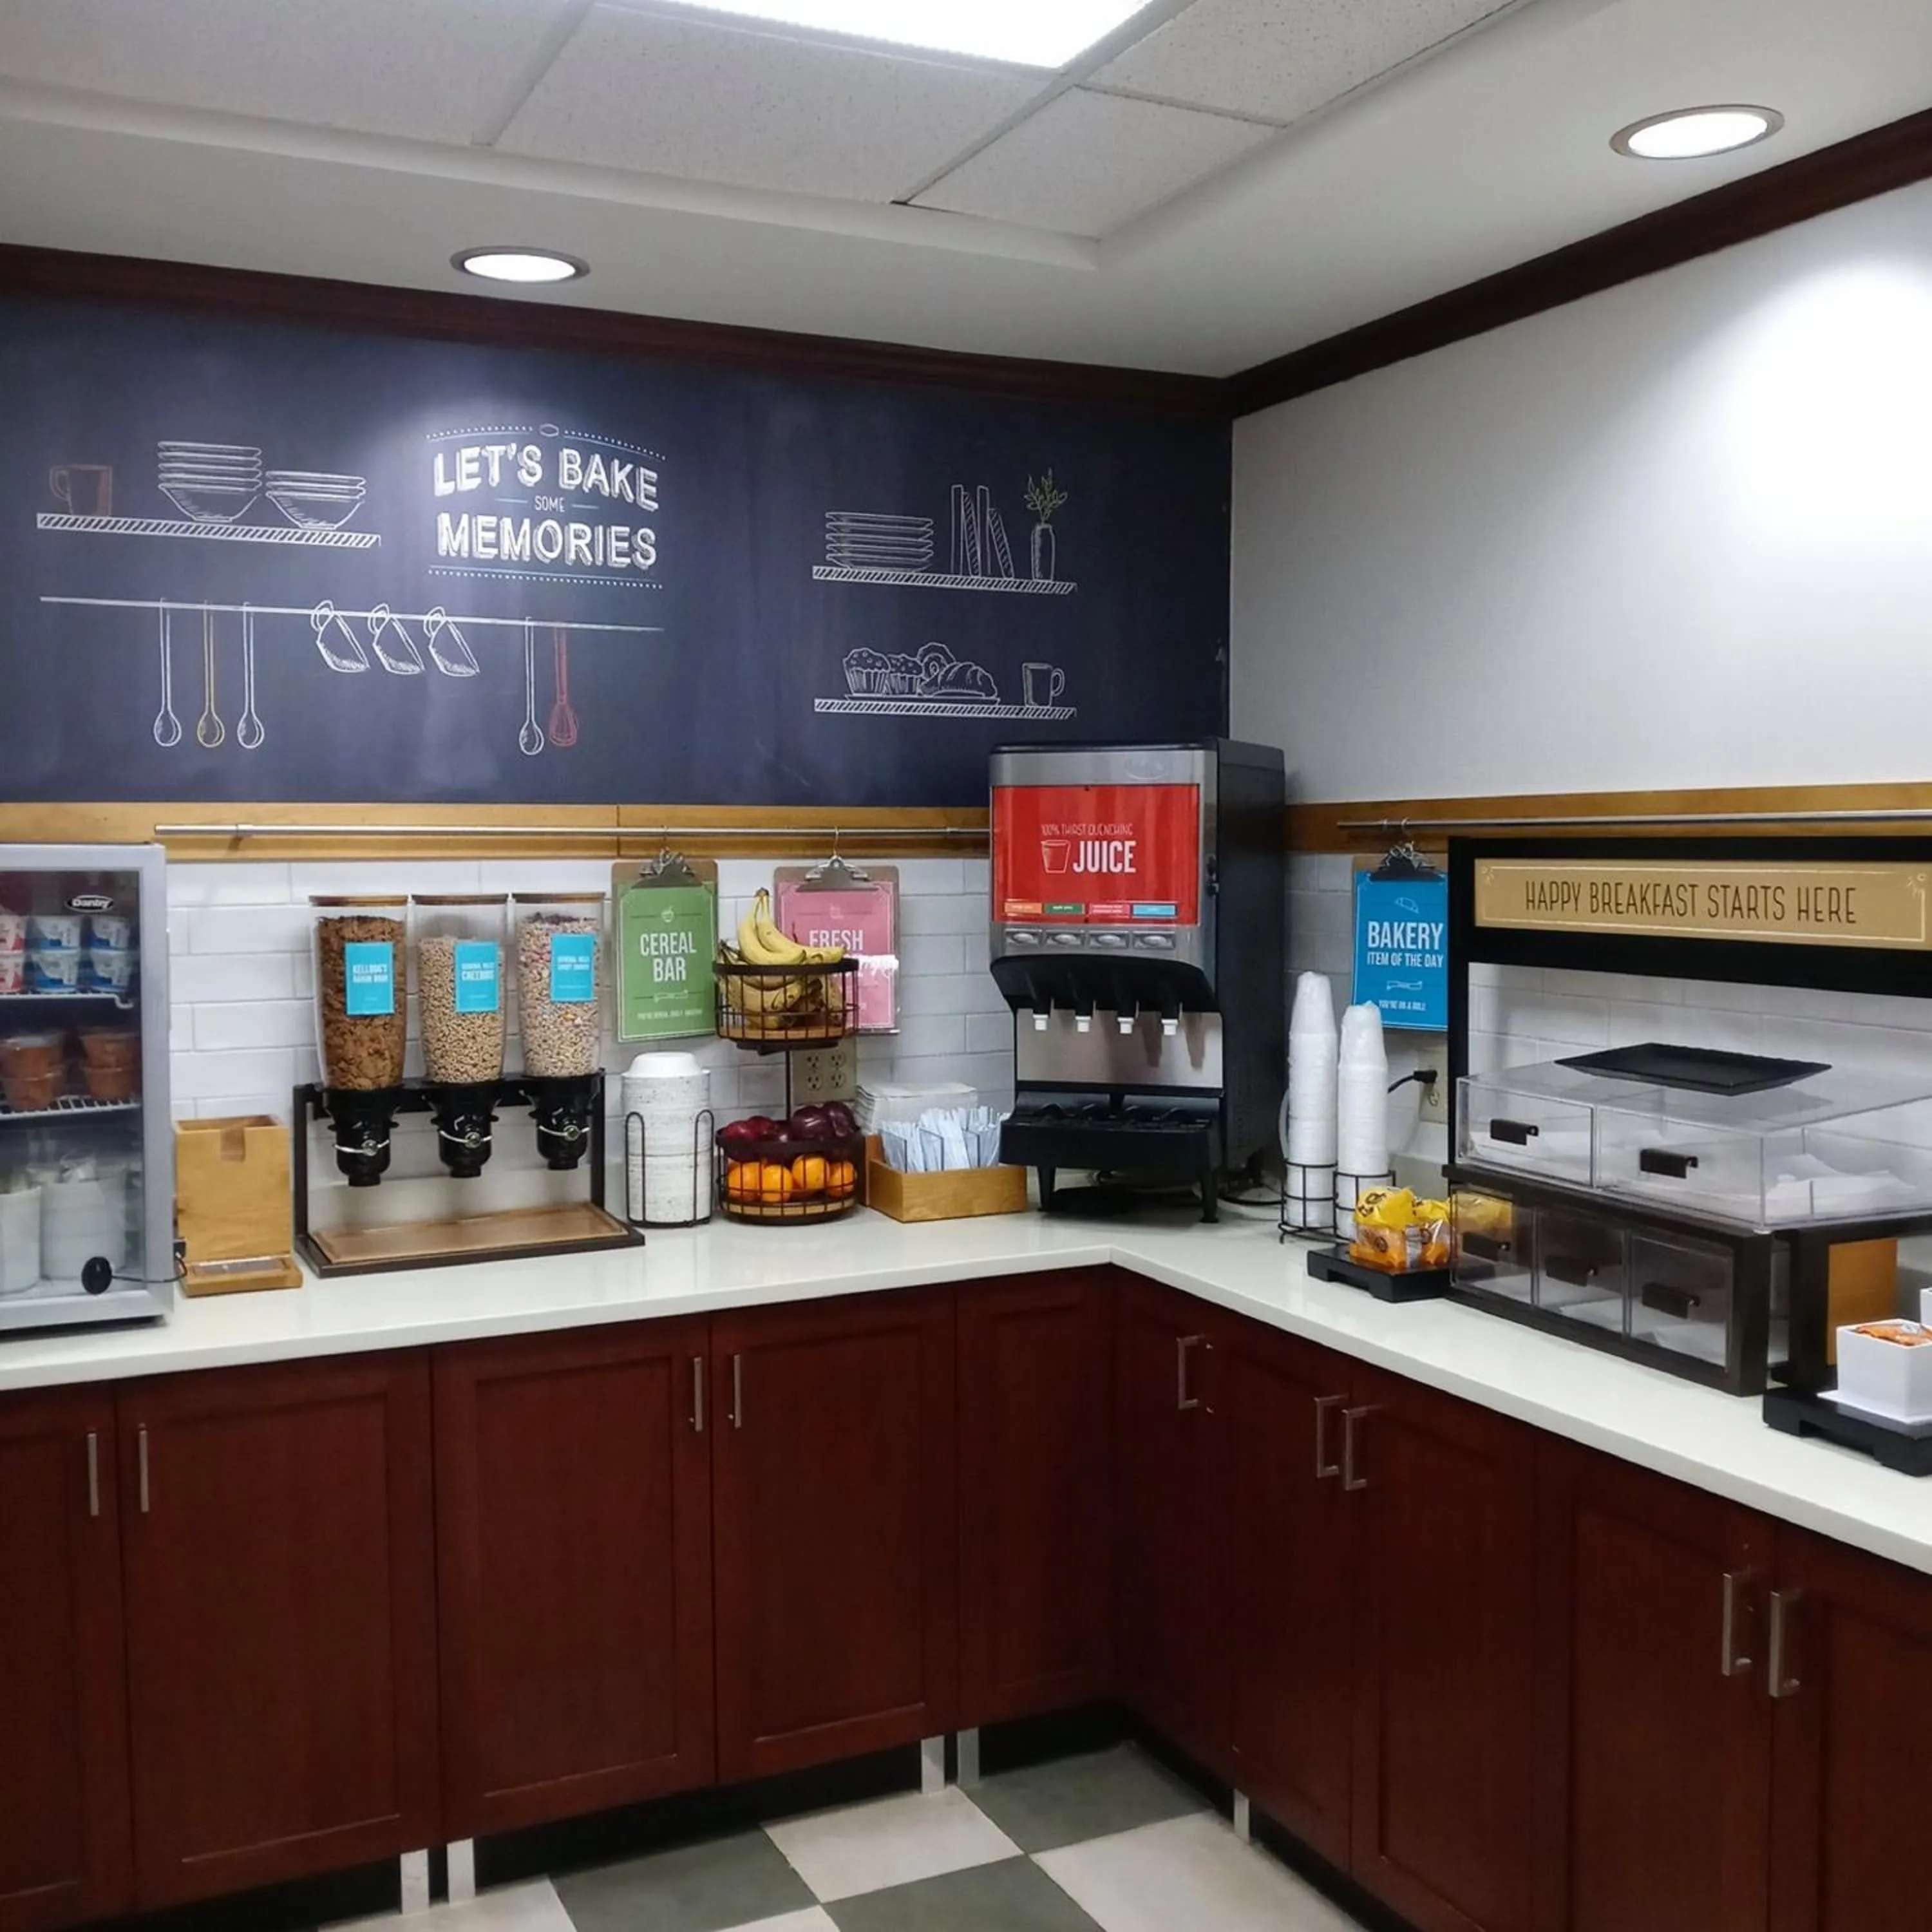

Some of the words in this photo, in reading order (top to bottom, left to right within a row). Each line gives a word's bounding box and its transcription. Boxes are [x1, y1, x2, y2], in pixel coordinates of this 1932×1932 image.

[433, 443, 544, 497] LET'S
[558, 448, 659, 511] BAKE
[535, 496, 565, 513] SOME
[437, 513, 657, 570] MEMORIES
[1072, 840, 1137, 873] JUICE
[1525, 880, 1582, 914] HAPPY
[1589, 882, 1699, 917] BREAKFAST
[1707, 884, 1785, 921] STARTS
[1797, 886, 1857, 924] HERE
[640, 932, 697, 956] CEREAL
[809, 929, 864, 951] FRESH
[1368, 921, 1443, 950] BAKERY
[653, 957, 686, 982] BAR
[1367, 951, 1389, 965] ITEM
[1390, 952, 1402, 966] OF
[1405, 953, 1422, 967] THE
[1424, 954, 1443, 968] DAY
